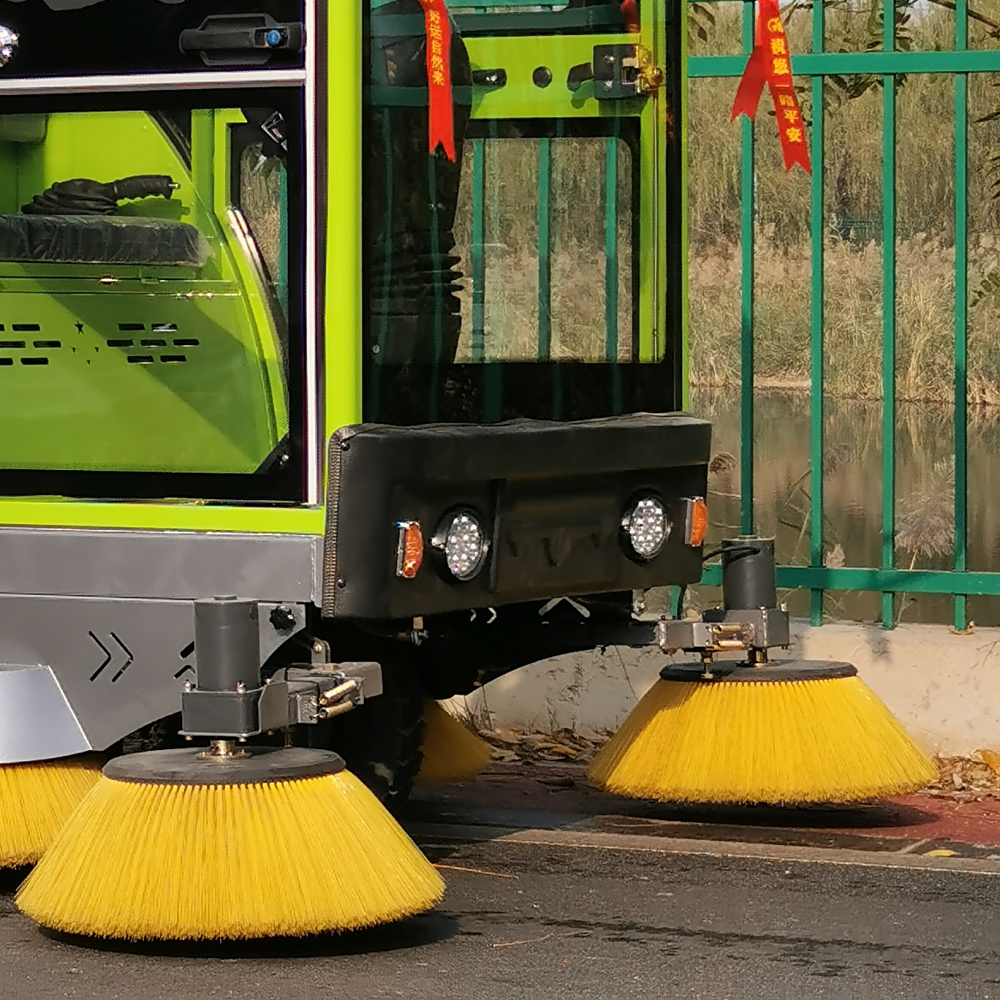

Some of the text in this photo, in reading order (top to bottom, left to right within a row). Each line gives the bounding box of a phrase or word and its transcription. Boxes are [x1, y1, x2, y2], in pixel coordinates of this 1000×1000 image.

[770, 37, 802, 143] 祝您一路平安
